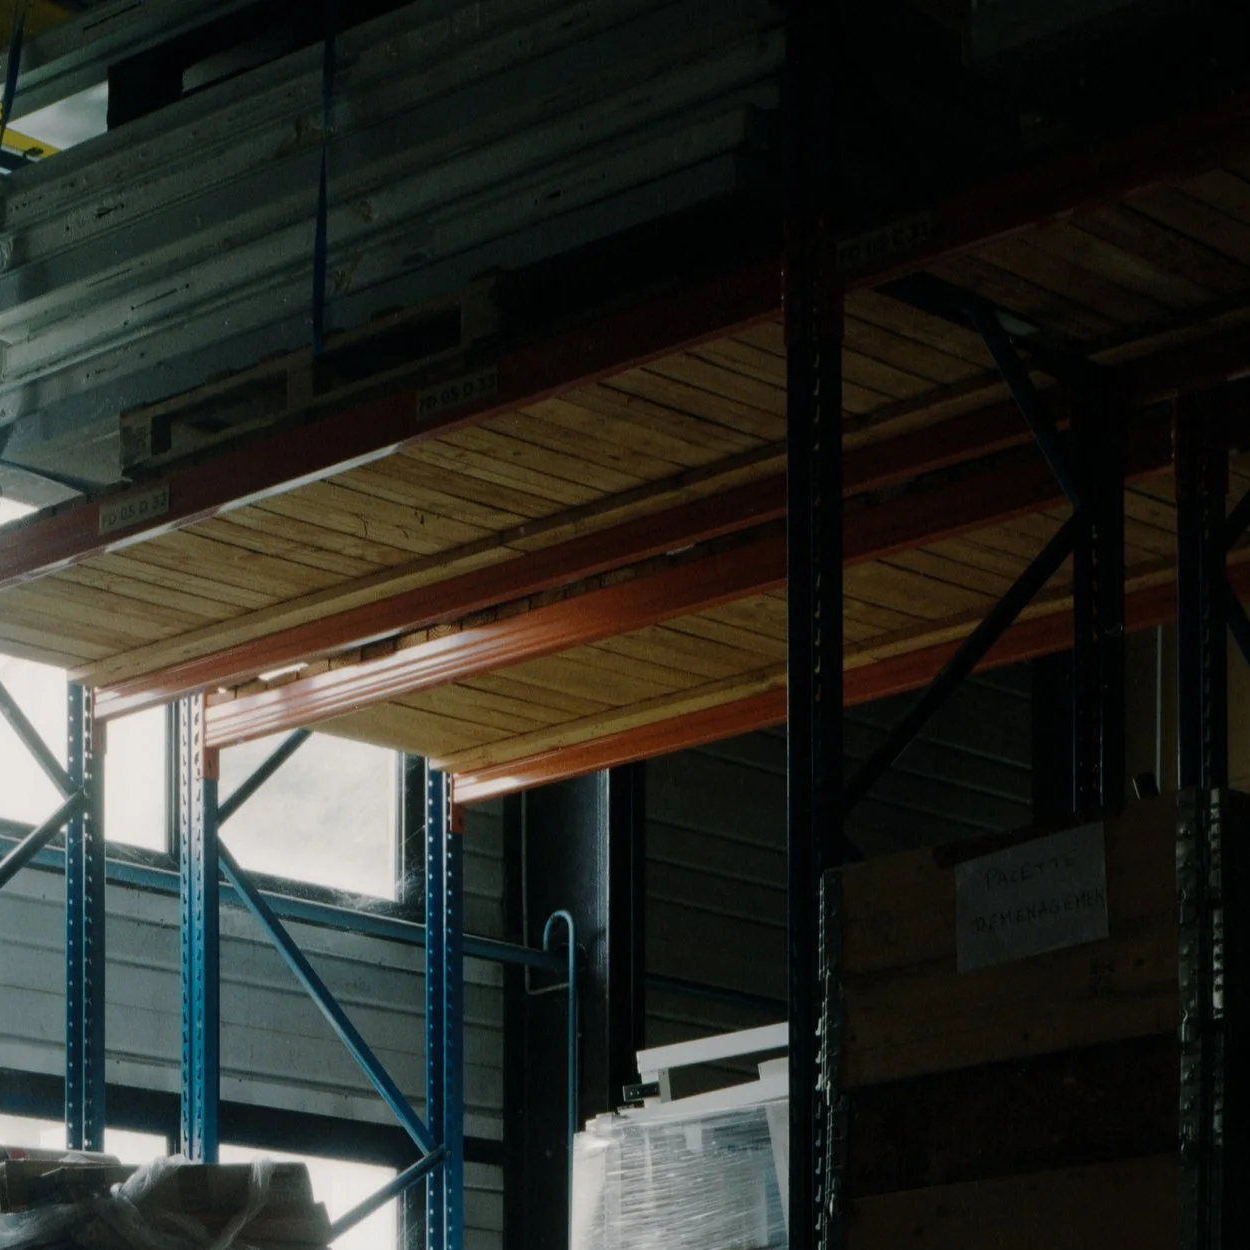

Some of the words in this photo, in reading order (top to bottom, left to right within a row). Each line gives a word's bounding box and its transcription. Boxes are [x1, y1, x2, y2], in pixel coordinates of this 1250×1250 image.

[419, 394, 438, 412] FD
[441, 386, 459, 404] 05
[463, 382, 473, 397] D
[102, 511, 117, 528] FD
[120, 504, 136, 520] 05
[139, 500, 148, 514] D
